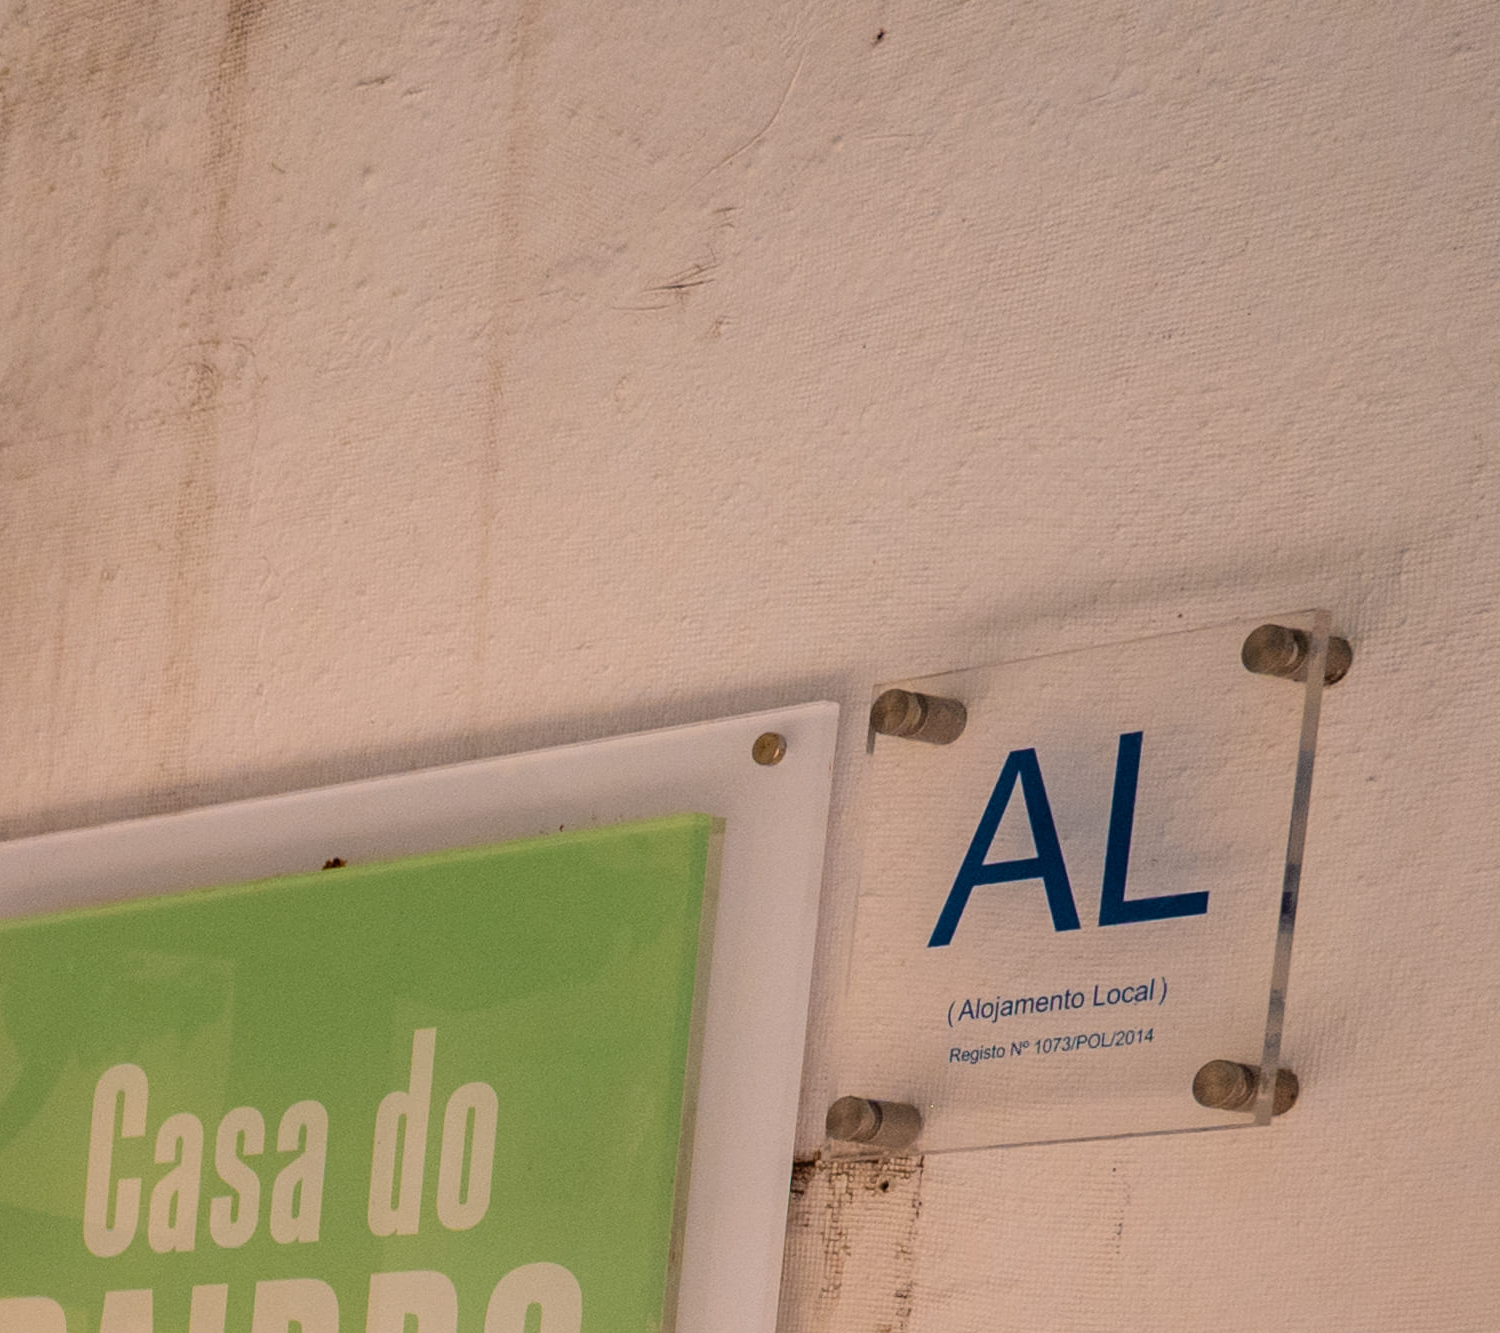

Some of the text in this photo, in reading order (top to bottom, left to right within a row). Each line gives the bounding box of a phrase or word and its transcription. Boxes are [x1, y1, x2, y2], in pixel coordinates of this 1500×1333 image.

[926, 730, 1210, 948] AL
[83, 1027, 499, 1258] Casa do
[948, 1043, 1006, 1064] Registo
[1035, 1028, 1155, 1055] 1073/POL/2014
